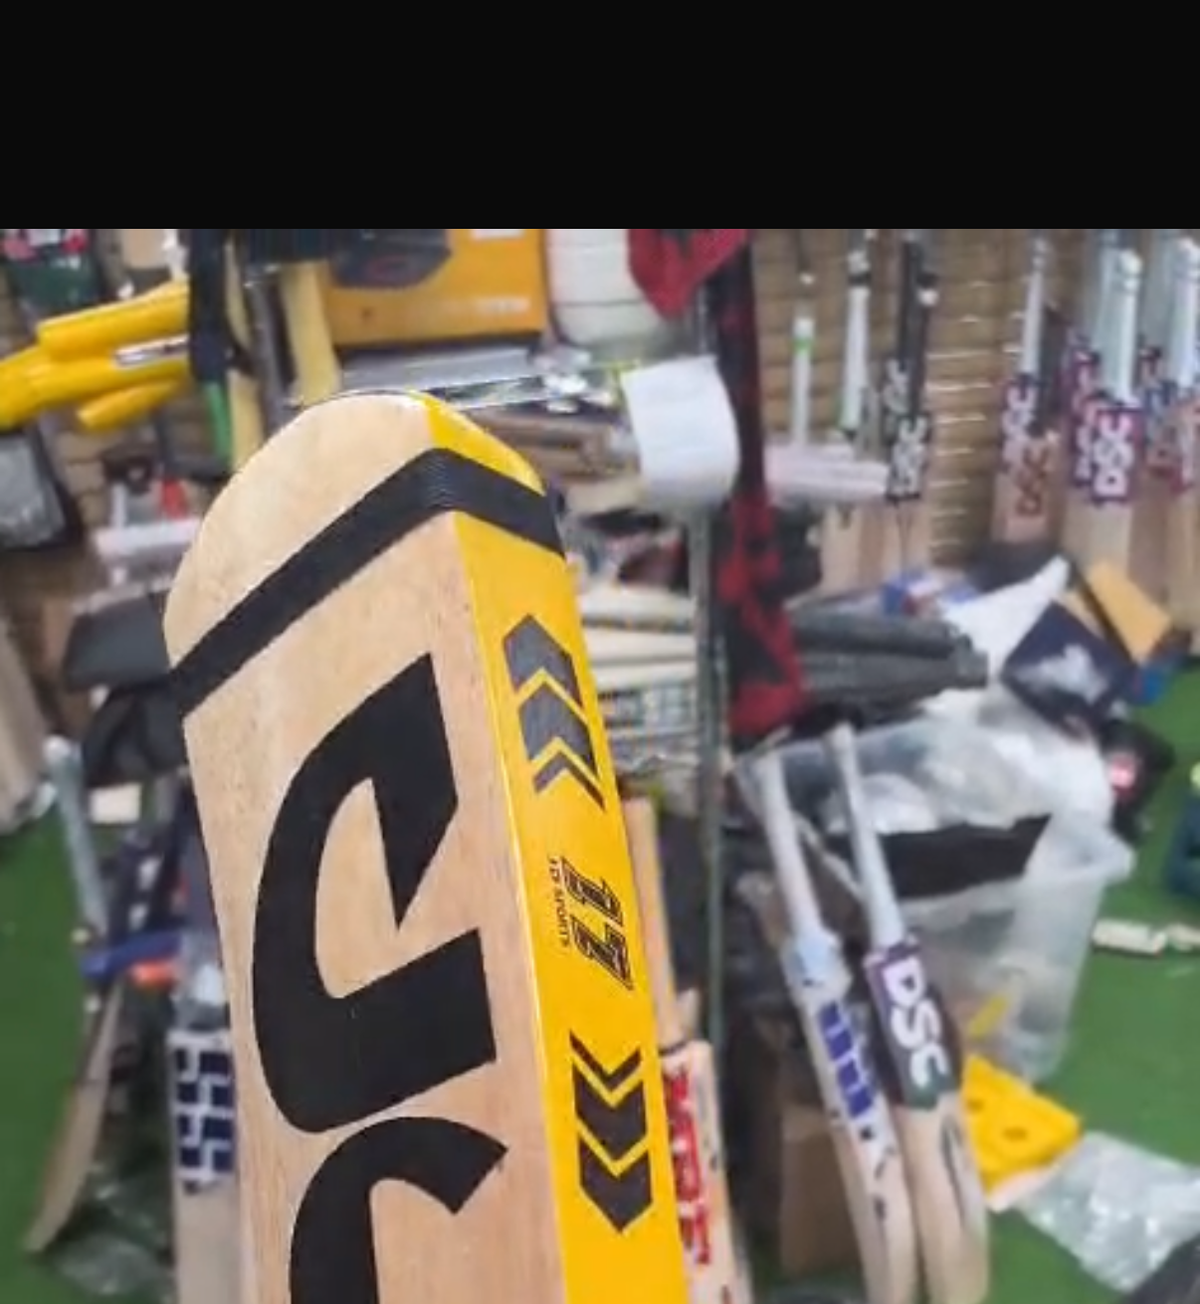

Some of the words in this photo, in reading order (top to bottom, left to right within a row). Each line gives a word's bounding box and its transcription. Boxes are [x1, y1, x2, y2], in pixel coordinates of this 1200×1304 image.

[1093, 412, 1135, 497] DSC
[559, 856, 635, 991] 17
[882, 955, 948, 1089] DSC
